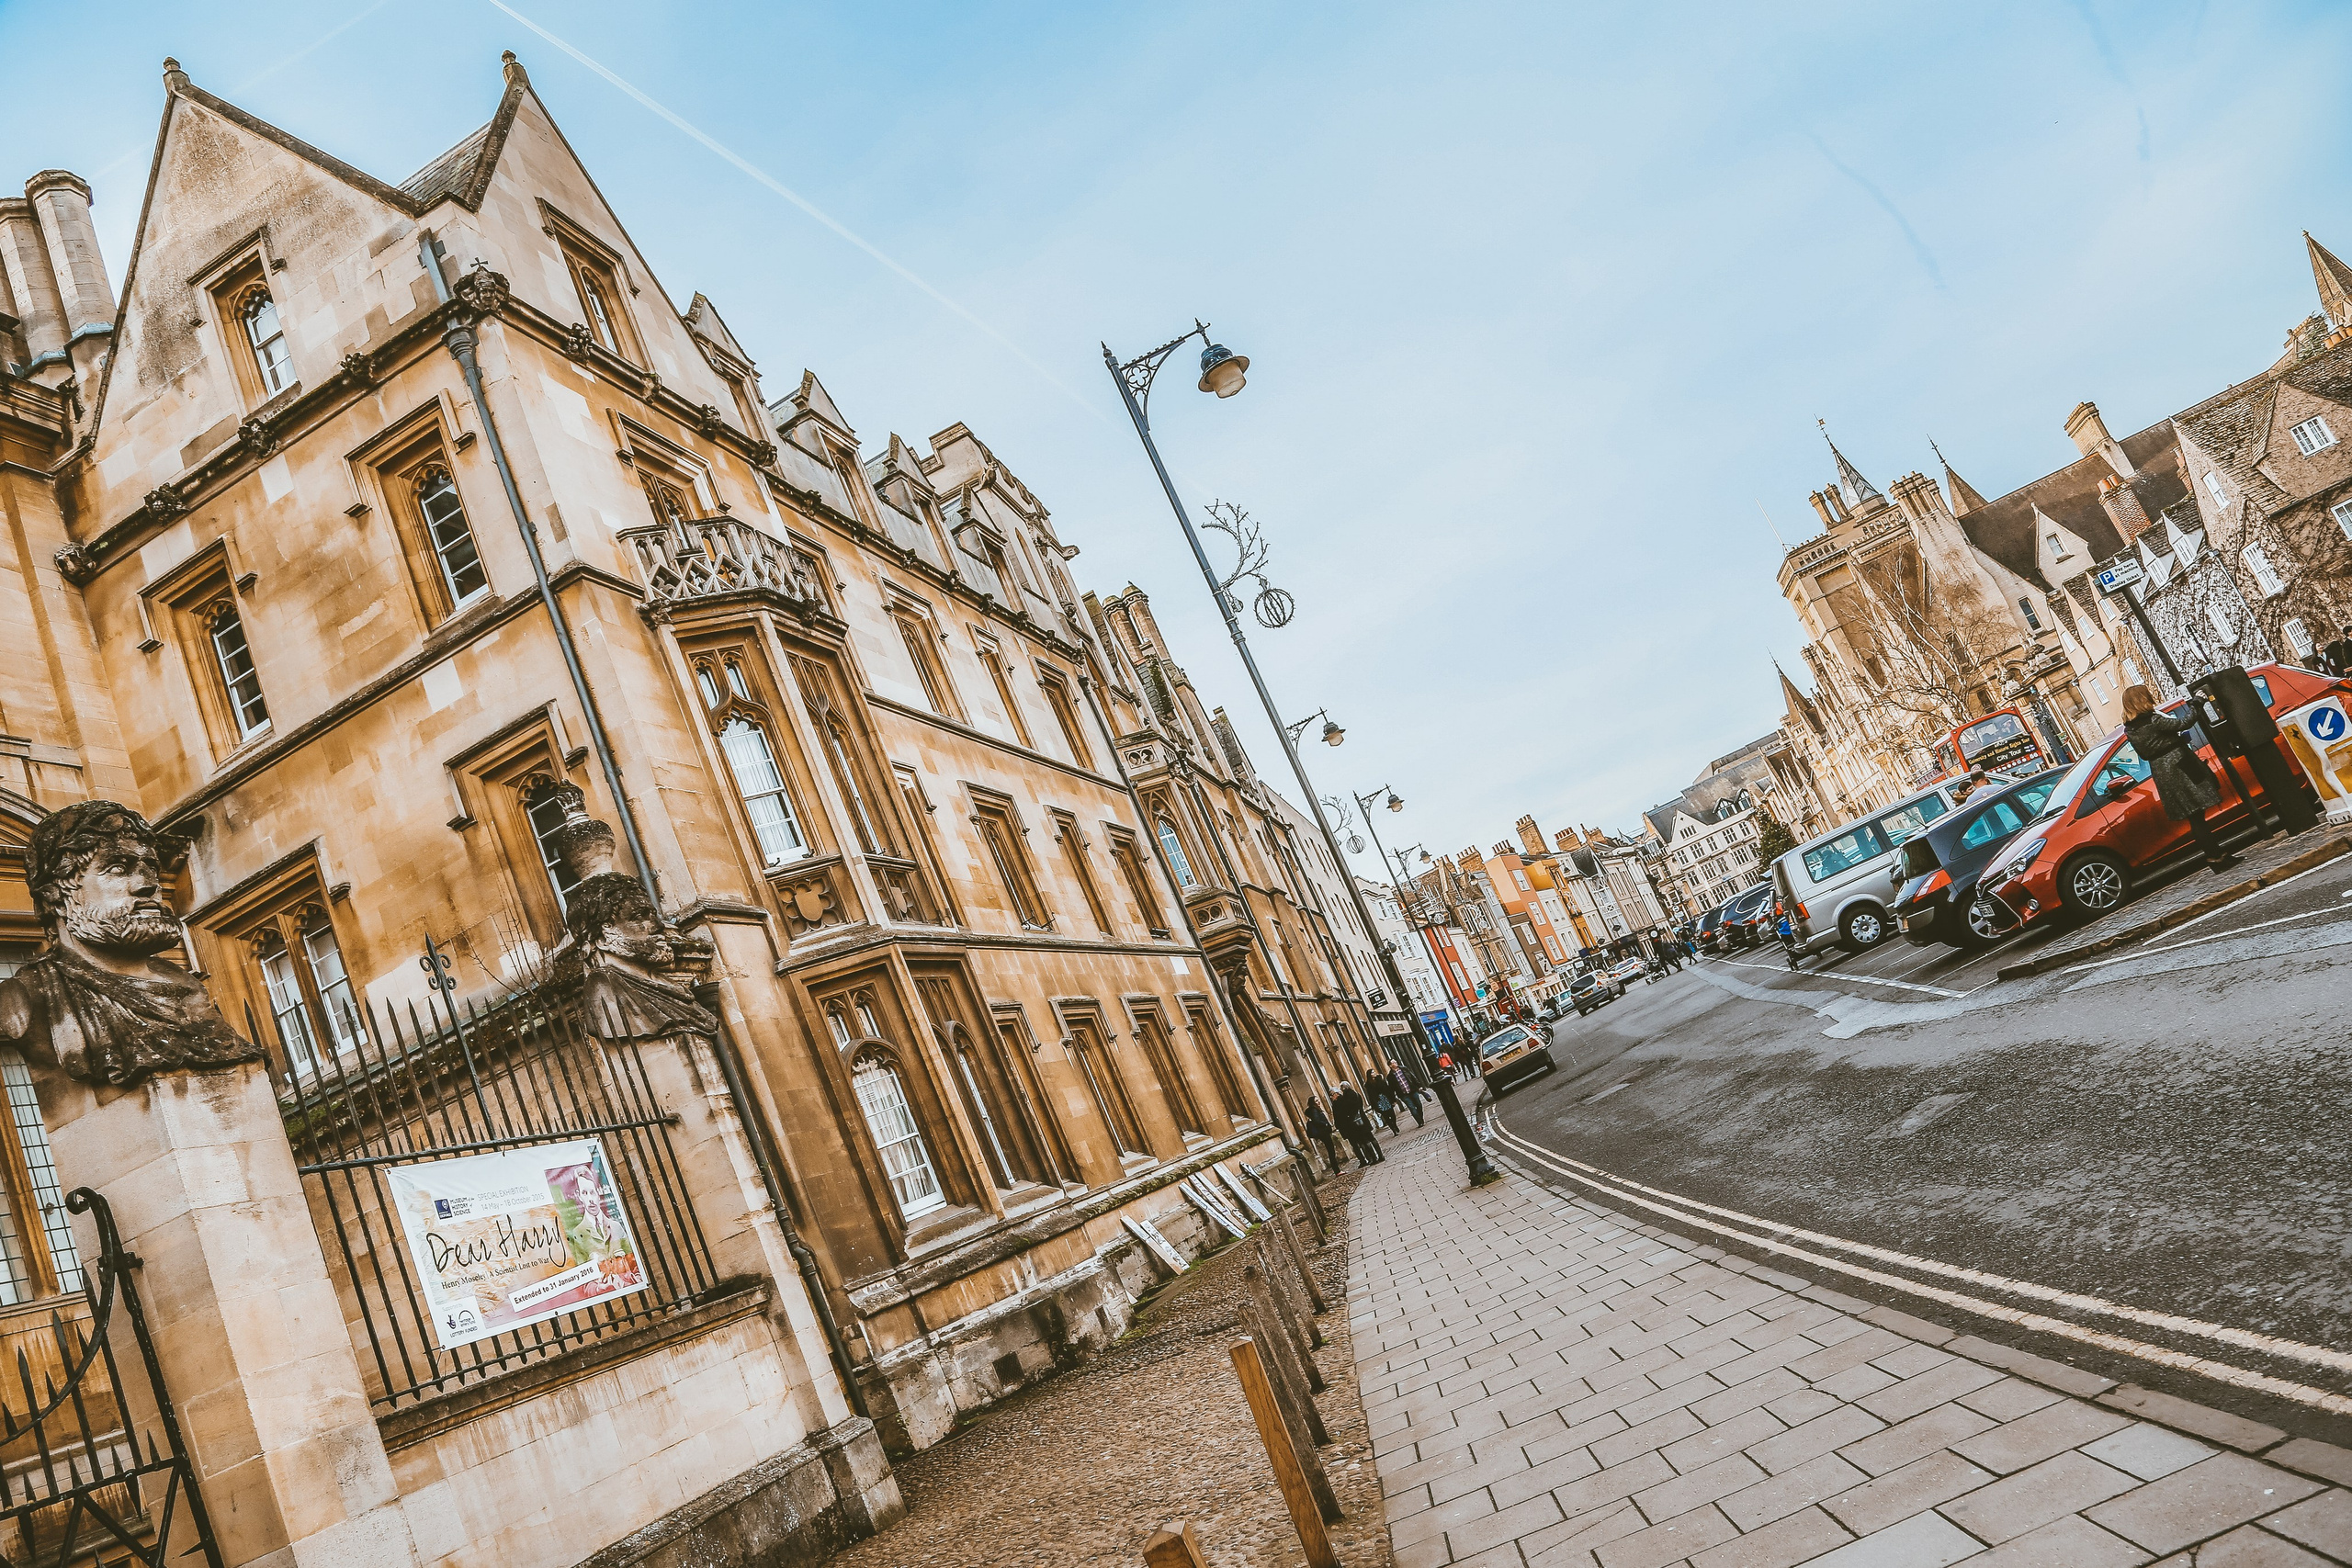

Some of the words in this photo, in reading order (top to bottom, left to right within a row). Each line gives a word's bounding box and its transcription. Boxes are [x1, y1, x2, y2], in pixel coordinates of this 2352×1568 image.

[2120, 565, 2138, 575] machine
[2103, 573, 2111, 583] P
[2110, 580, 2126, 589] Display
[1968, 755, 1987, 764] University
[477, 1191, 498, 1201] SPECIAL
[499, 1186, 529, 1197] EXHIBITION
[511, 1196, 531, 1206] October
[426, 1232, 492, 1273] Dear
[496, 1214, 566, 1268] Harry
[441, 1280, 461, 1290] Henry
[461, 1274, 486, 1285] Moseley
[495, 1266, 518, 1276] Scientist
[514, 1288, 542, 1304] Extended
[550, 1282, 558, 1290] 31
[558, 1274, 580, 1286] January
[580, 1266, 594, 1277] 2016
[450, 1330, 464, 1338] LOTTERY
[465, 1325, 478, 1334] FUNDED
